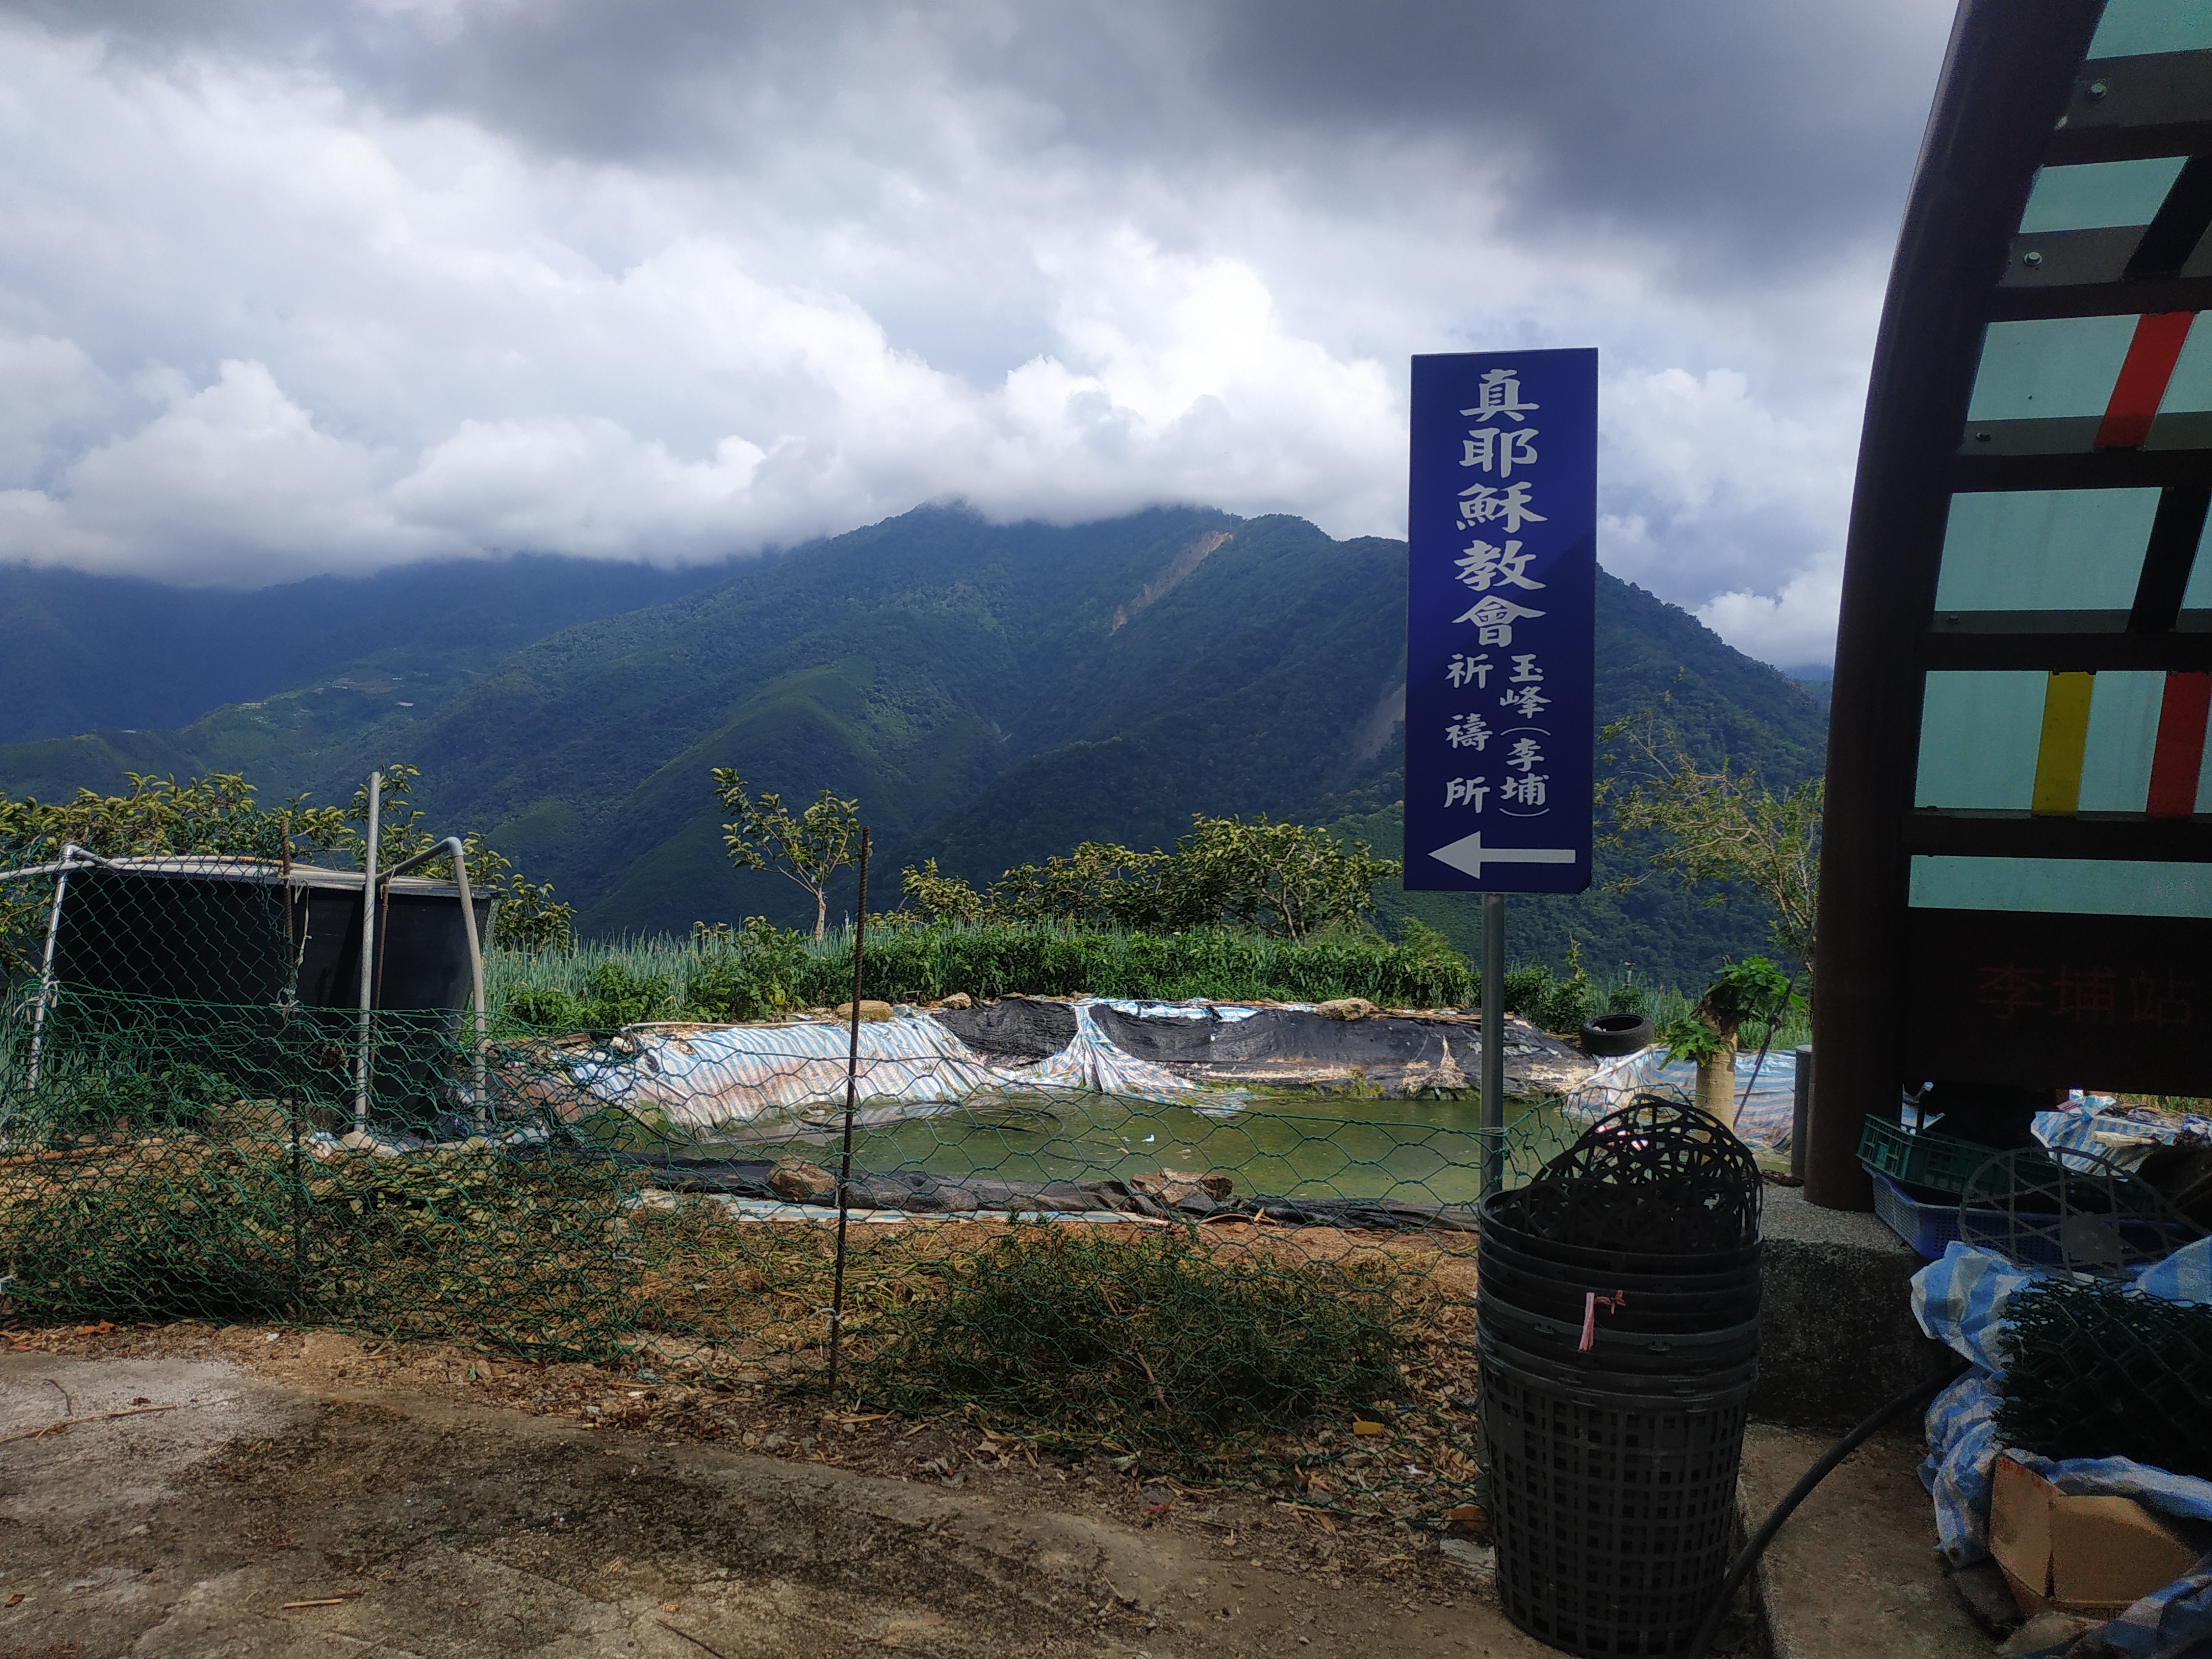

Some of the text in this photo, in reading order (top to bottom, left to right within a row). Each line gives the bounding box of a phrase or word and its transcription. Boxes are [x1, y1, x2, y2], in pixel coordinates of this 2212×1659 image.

[1452, 369, 1548, 648] 真耶穌教會
[1443, 653, 1494, 813] 祈禱所
[1978, 962, 2194, 1029] 李埔站
